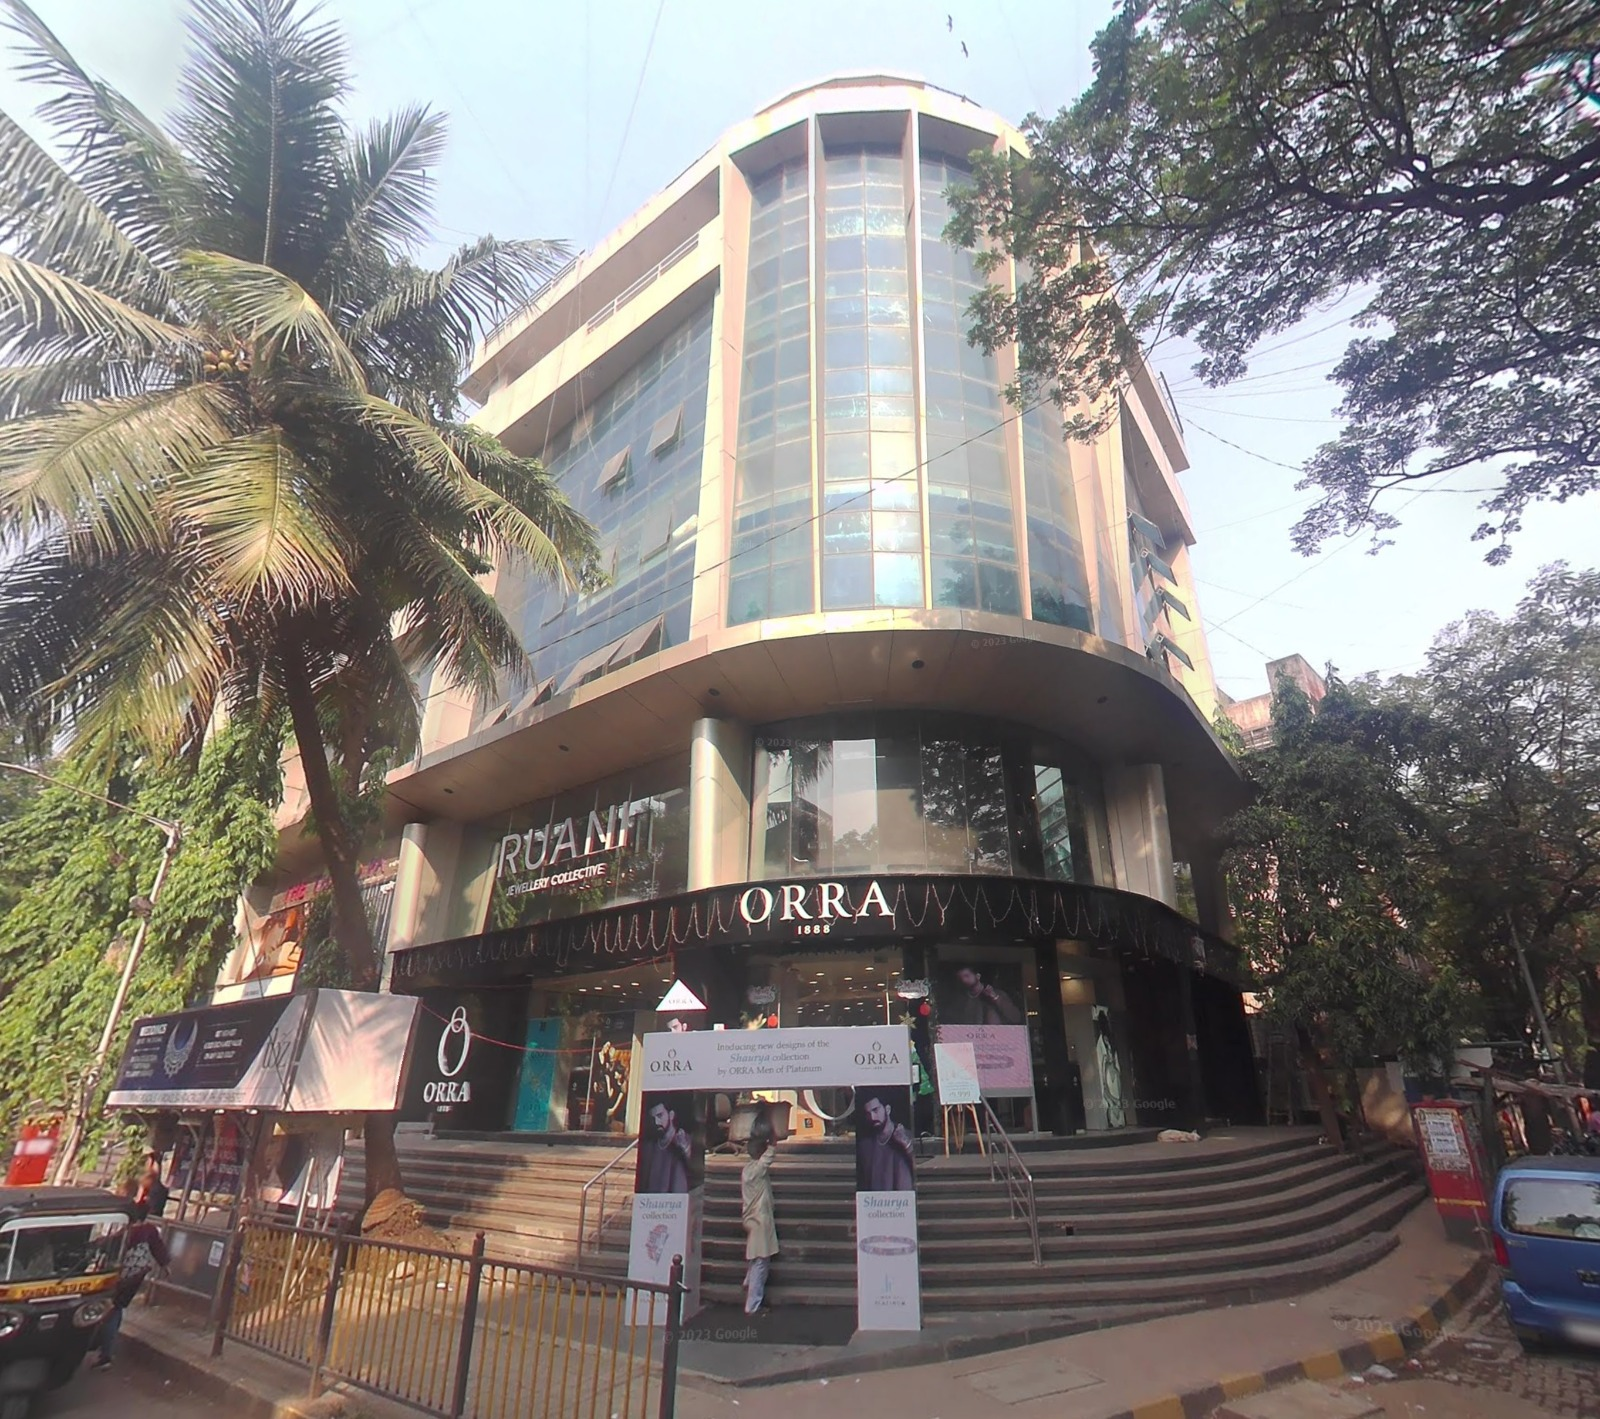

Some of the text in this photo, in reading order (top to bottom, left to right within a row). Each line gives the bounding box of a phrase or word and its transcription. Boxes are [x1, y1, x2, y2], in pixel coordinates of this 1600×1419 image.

[497, 800, 630, 879] RUANI
[506, 863, 608, 897] JEWELLERY COLLECTIVE
[740, 880, 895, 924] ORRA
[797, 925, 831, 935] 1888
[776, 1041, 806, 1051] designs
[807, 1040, 816, 1048] of
[817, 1039, 830, 1048] the
[730, 1053, 809, 1065] Shaurya collection
[854, 1052, 900, 1066] ORRA
[650, 1059, 693, 1073] ORRA
[717, 1064, 823, 1077] by ORRA Men of Platinum
[423, 1081, 471, 1103] ORRA
[639, 1199, 682, 1209] Shaurya
[863, 1196, 909, 1210] Shaurya
[642, 1212, 677, 1220] collection
[868, 1210, 905, 1219] collection
